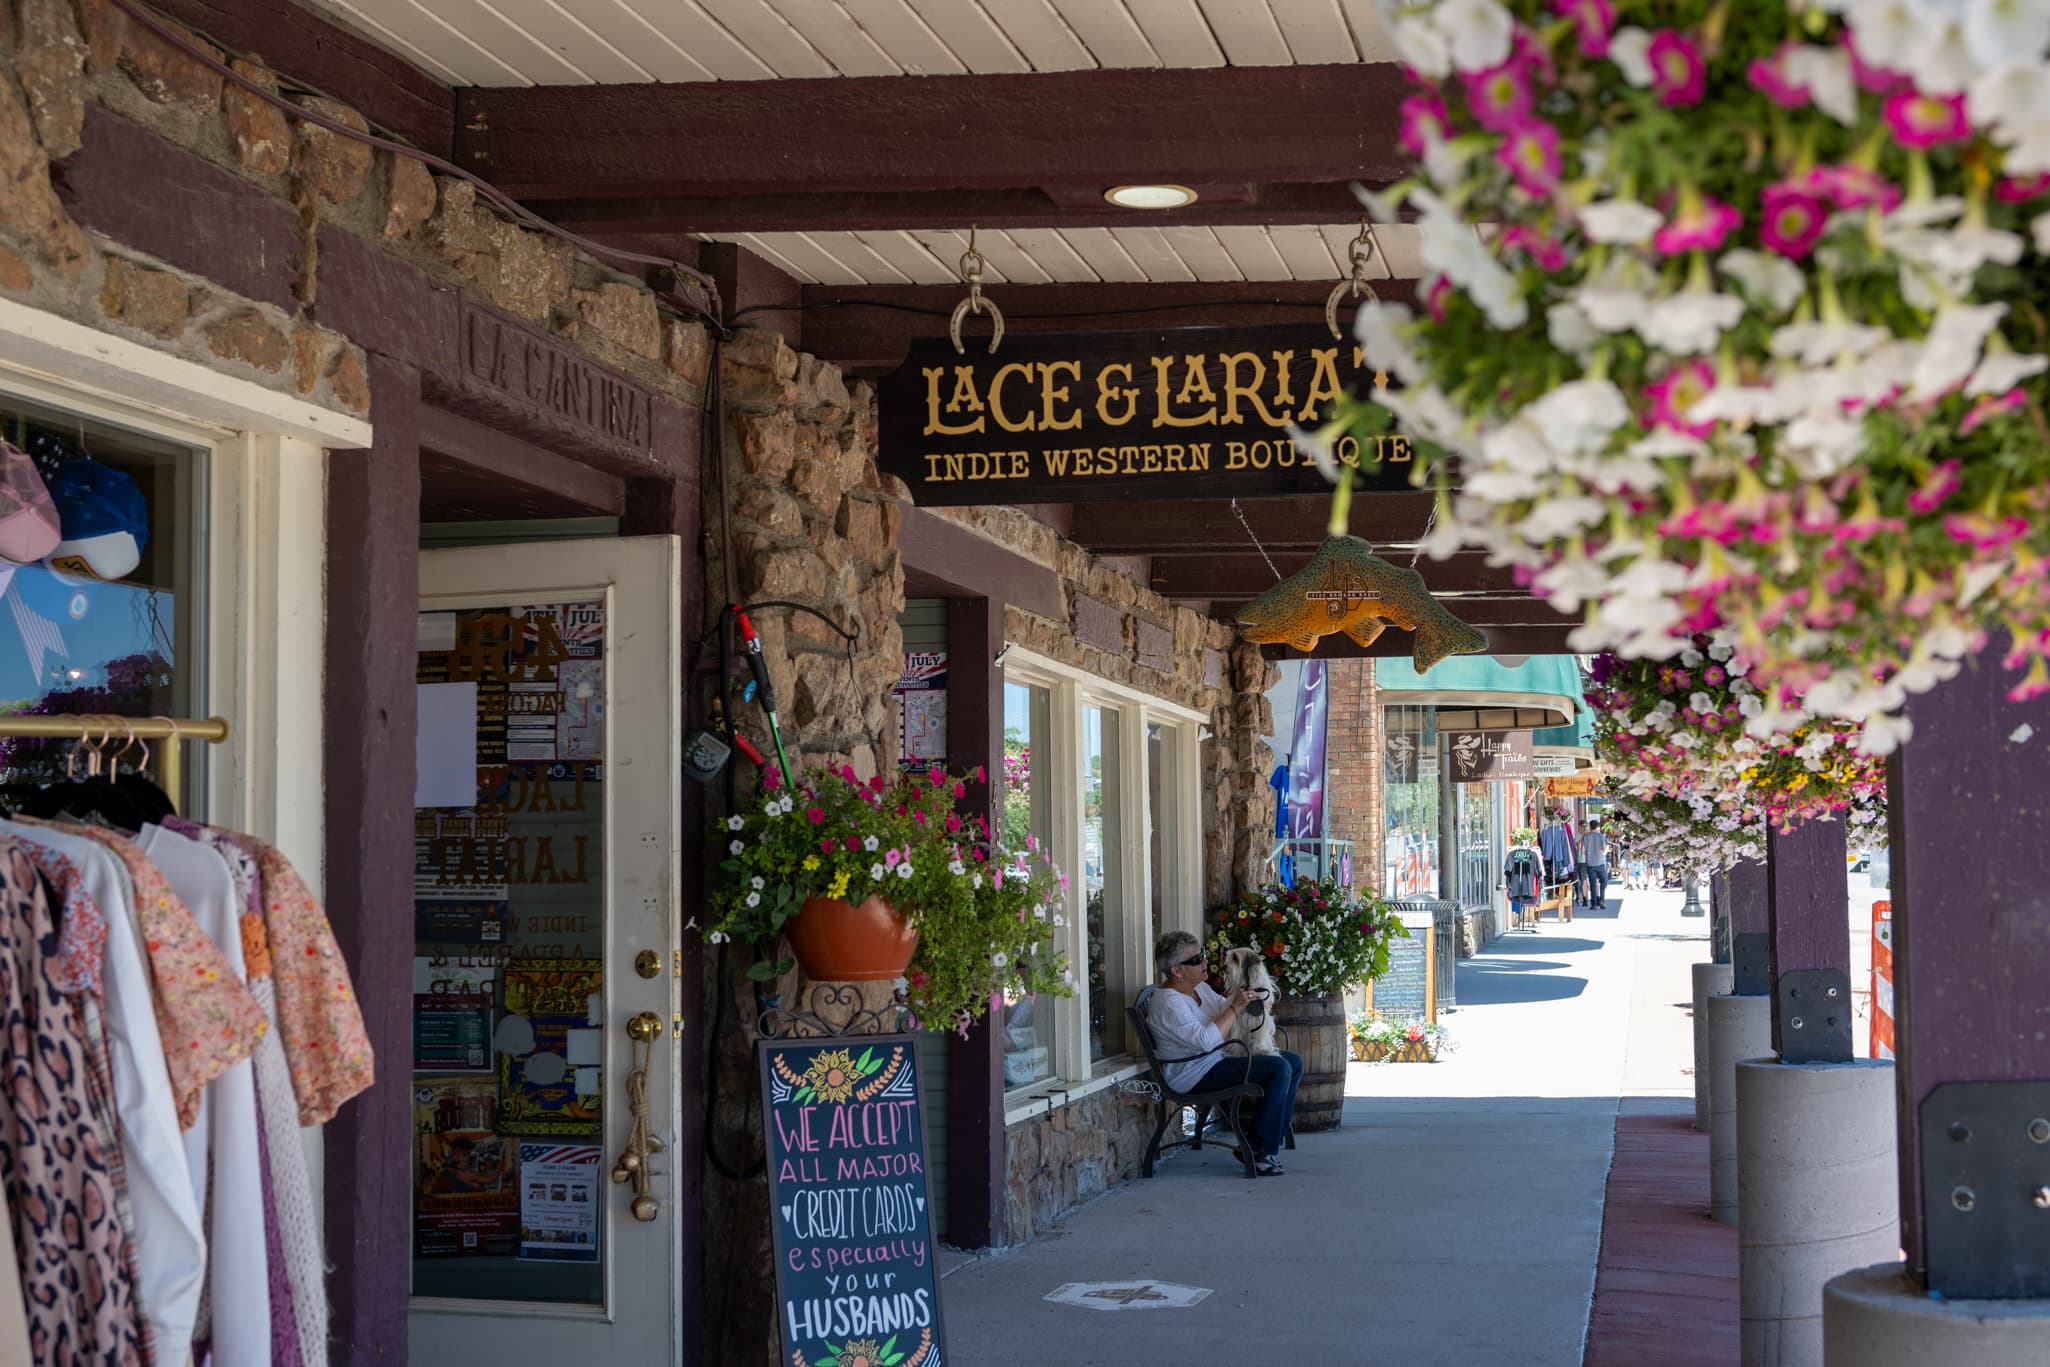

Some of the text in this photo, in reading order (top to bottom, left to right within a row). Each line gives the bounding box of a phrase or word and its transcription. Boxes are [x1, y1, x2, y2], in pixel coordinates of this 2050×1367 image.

[922, 360, 1082, 436] LACE
[1095, 364, 1140, 426] &
[924, 452, 1029, 482] INDIE
[1044, 443, 1212, 476] WESTERN
[570, 610, 603, 627] JUL
[911, 656, 941, 668] JULY
[1480, 733, 1528, 770] Happy Trails
[774, 1100, 917, 1153] WE ACCEPT
[779, 1152, 922, 1183] ALL MAJOR
[793, 1183, 916, 1239] CREDIT CARDS
[788, 1239, 926, 1272] especially
[825, 1272, 896, 1295] your
[786, 1288, 931, 1342] HUSBANDS
